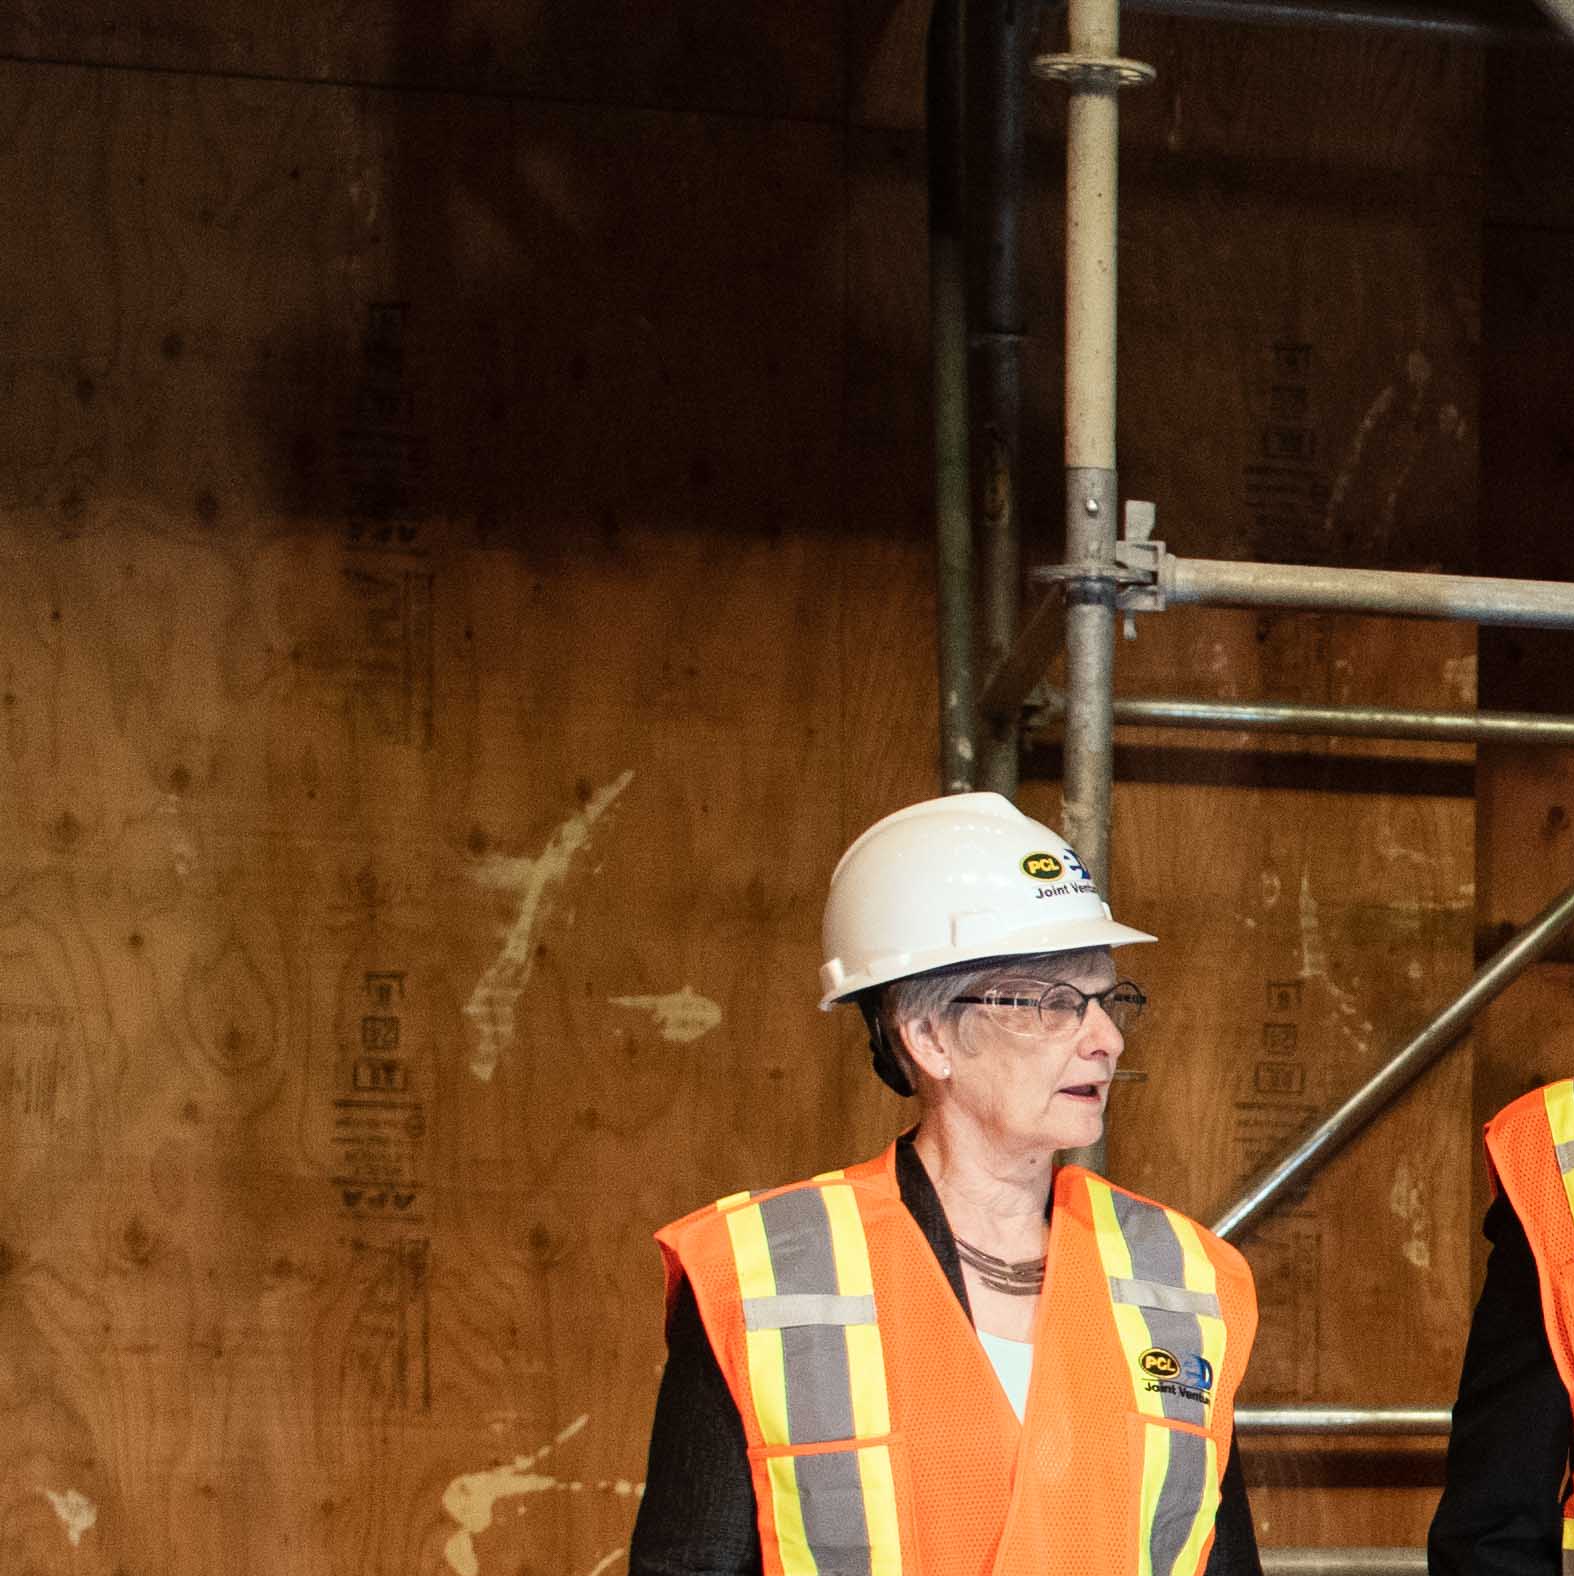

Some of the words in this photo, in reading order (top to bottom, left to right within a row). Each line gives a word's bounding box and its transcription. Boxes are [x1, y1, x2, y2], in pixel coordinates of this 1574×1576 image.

[1027, 857, 1060, 875] PCL
[1035, 884, 1071, 900] Joint
[1144, 1355, 1177, 1373] PCL
[1144, 1381, 1177, 1396] Joint
